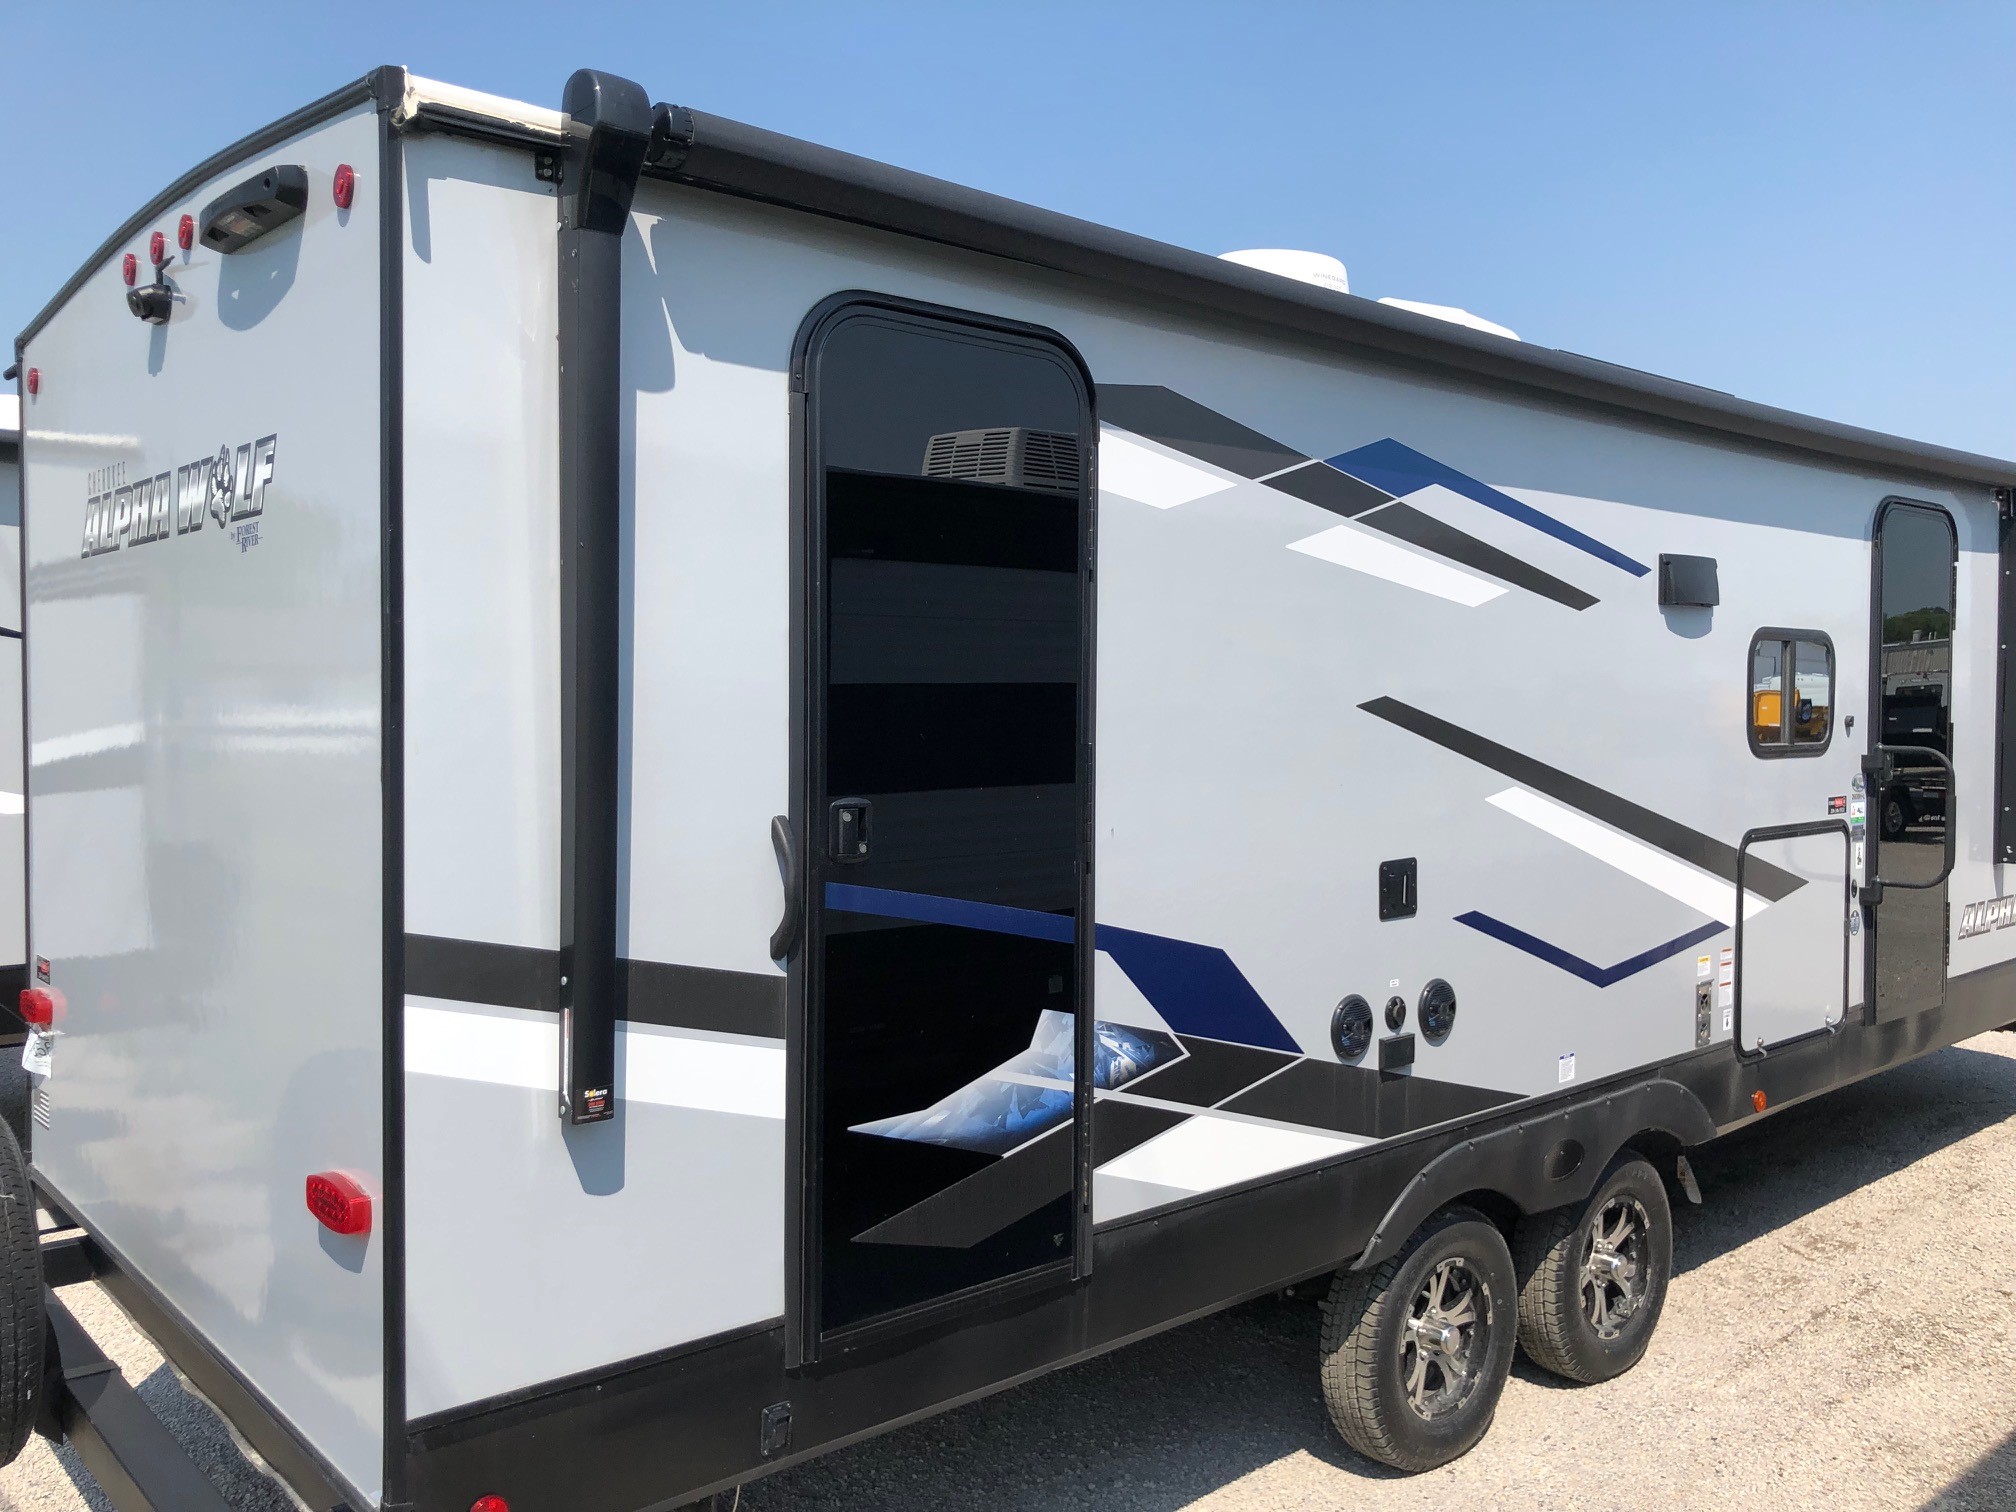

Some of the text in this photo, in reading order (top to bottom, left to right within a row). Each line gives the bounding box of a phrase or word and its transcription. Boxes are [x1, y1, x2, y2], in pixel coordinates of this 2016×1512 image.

[81, 471, 171, 559] ALPHA
[236, 521, 260, 542] FOREST
[241, 533, 259, 553] RIVER
[1957, 894, 2016, 940] ALPH
[584, 1088, 608, 1098] Solera
